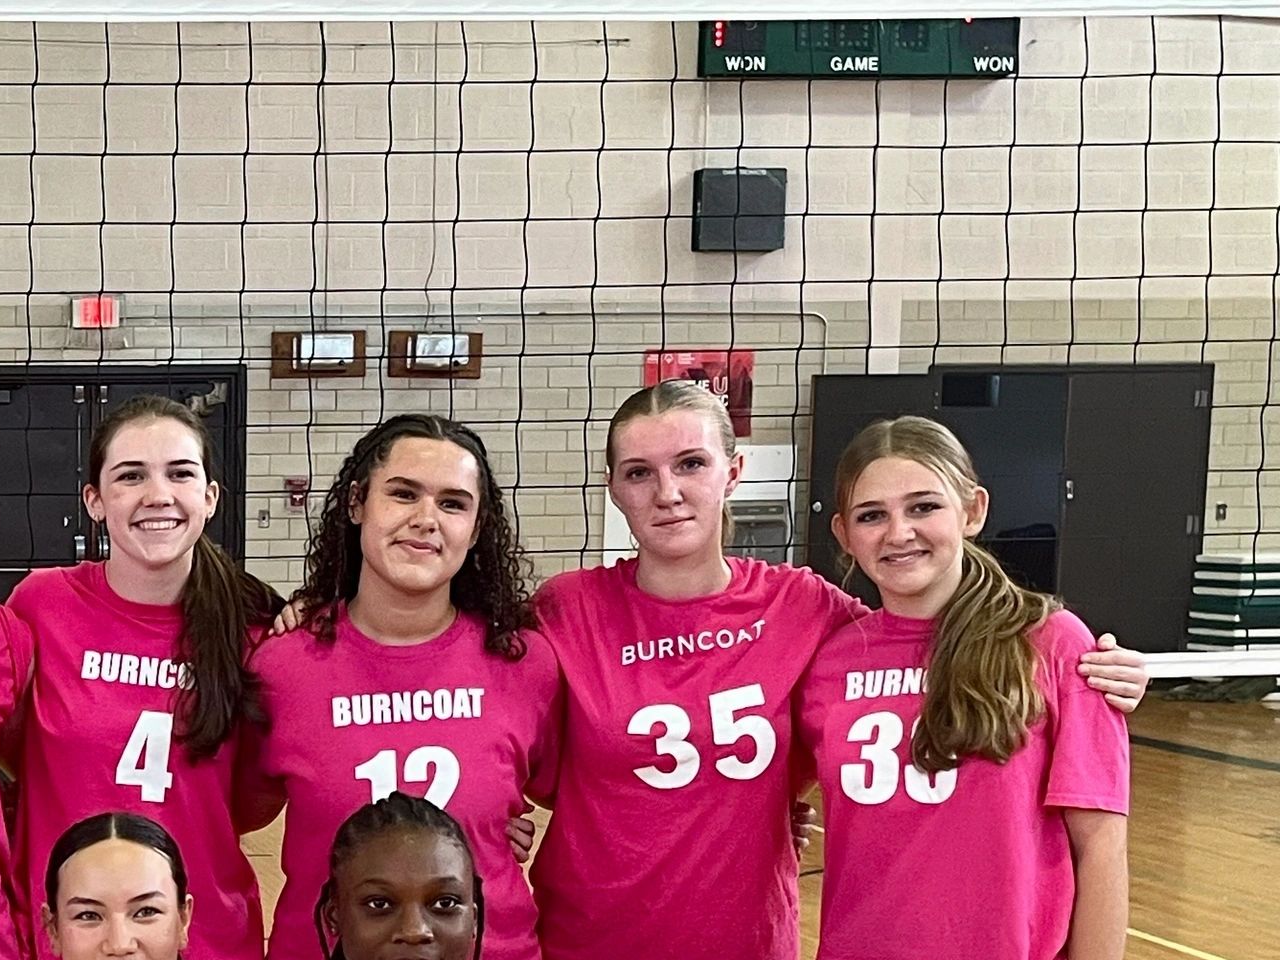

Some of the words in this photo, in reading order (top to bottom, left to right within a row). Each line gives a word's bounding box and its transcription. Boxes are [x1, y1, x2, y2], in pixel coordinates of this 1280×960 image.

[725, 56, 766, 71] WON
[830, 56, 879, 72] GAME
[973, 56, 1014, 72] WON
[622, 619, 766, 665] BURNCOAT
[81, 649, 196, 690] BURNCO
[845, 667, 928, 701] BURN
[331, 688, 485, 728] BURNCOAT
[115, 710, 174, 803] 4
[626, 683, 777, 790] 35
[354, 745, 461, 812] 12
